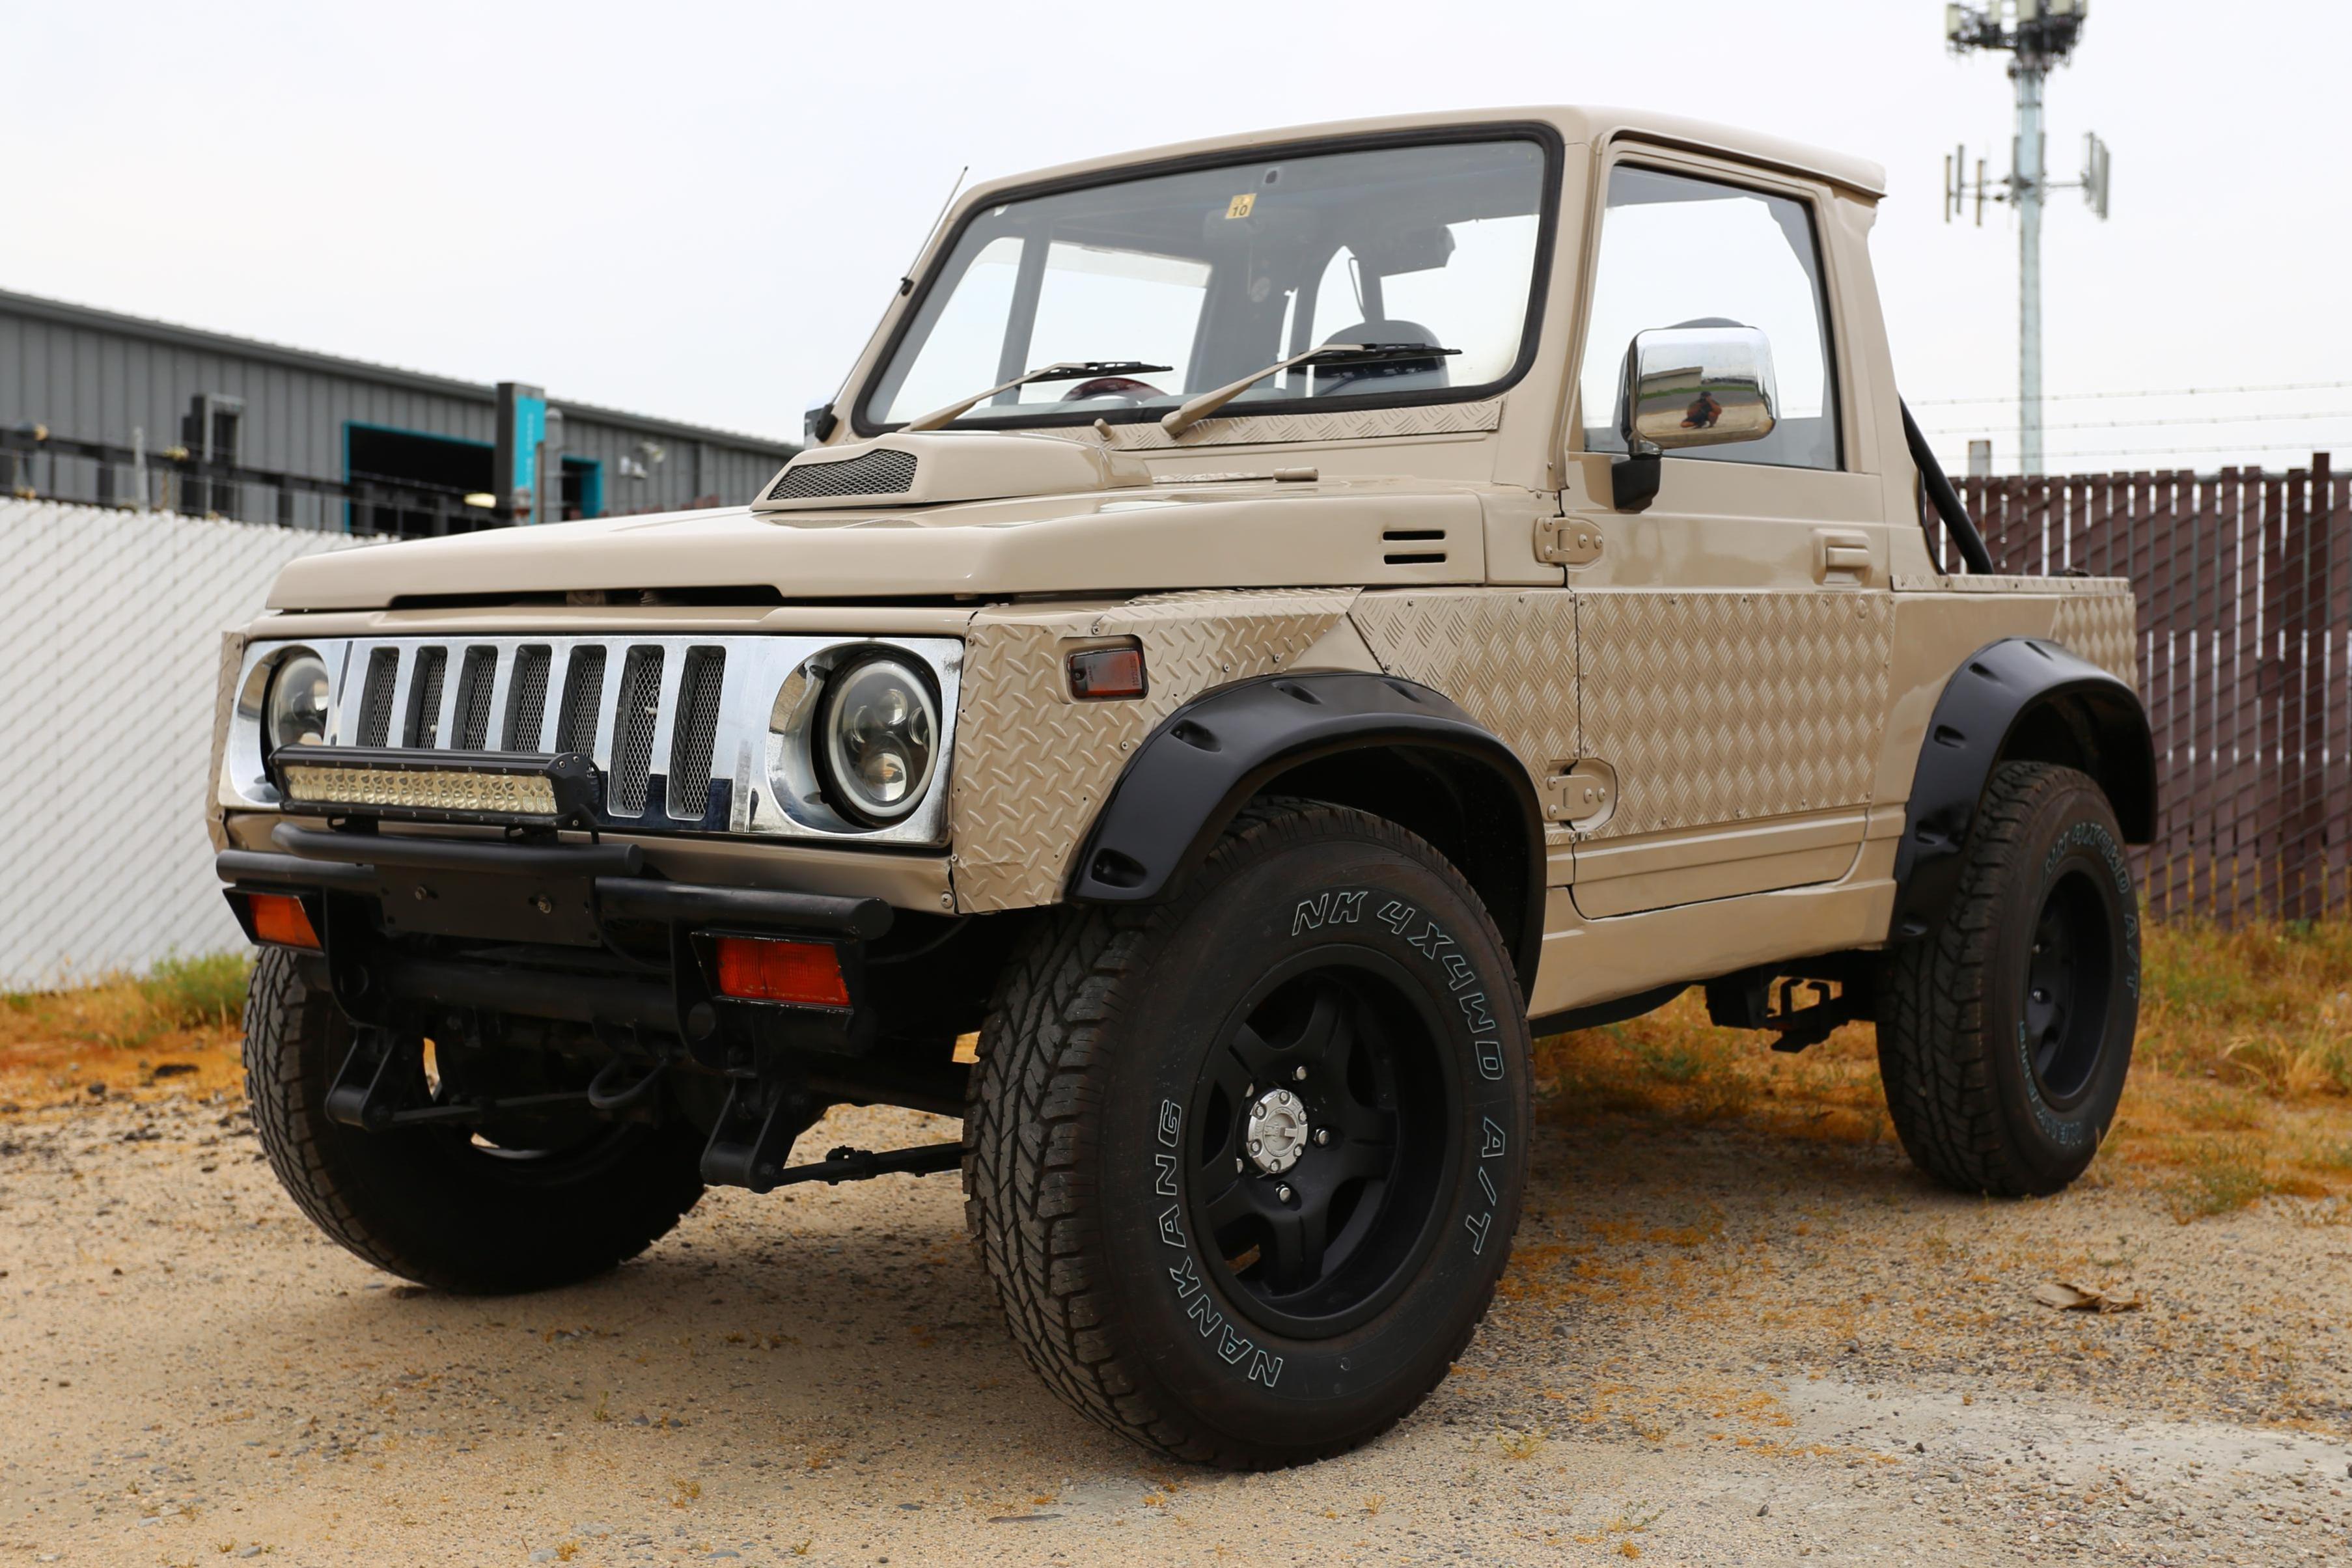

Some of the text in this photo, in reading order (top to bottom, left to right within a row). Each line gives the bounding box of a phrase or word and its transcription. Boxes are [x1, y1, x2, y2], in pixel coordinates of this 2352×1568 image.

[1232, 204, 1248, 217] 10
[2124, 913, 2138, 998] A/T
[1292, 891, 1505, 1255] NK 4X4WD A/T
[1155, 1099, 1283, 1388] NANKANG
